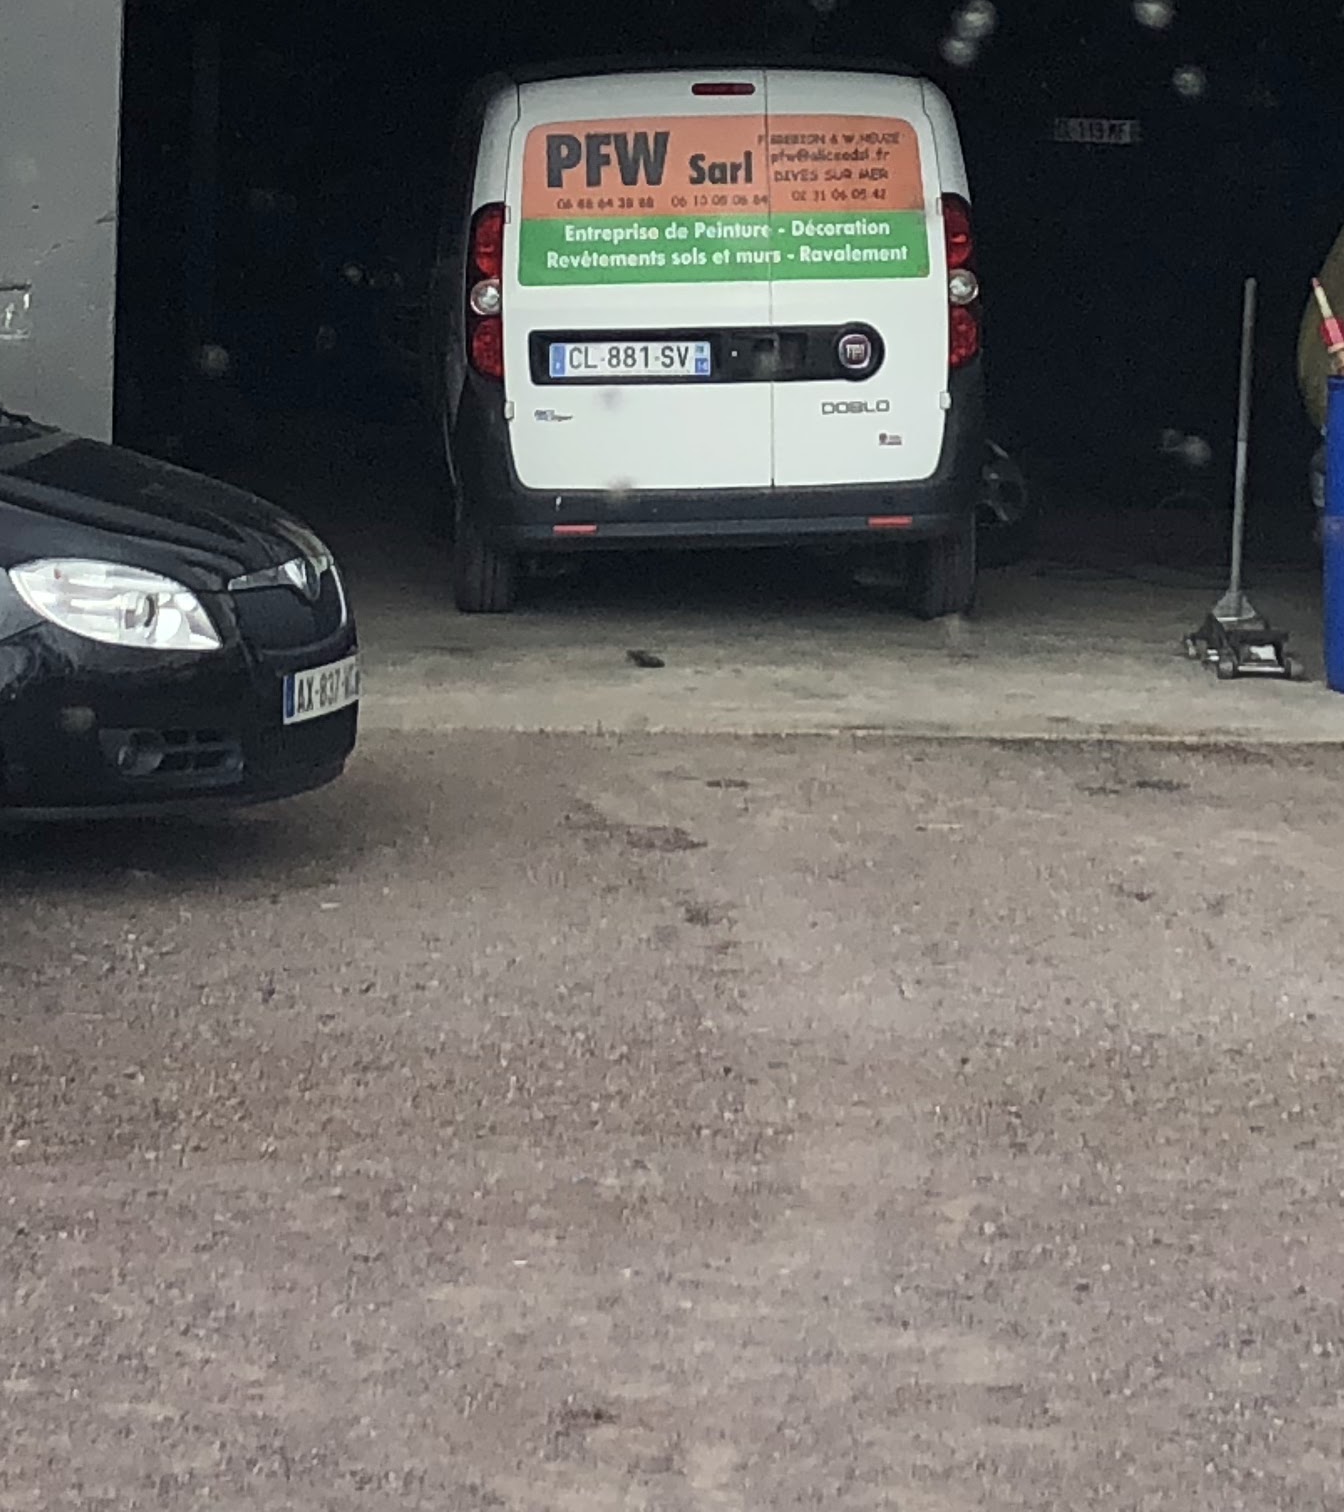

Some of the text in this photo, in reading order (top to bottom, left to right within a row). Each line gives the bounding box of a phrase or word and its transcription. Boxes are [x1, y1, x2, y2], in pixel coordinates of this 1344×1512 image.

[545, 131, 754, 189] PFW Sarl
[564, 223, 659, 245] Entreprise
[664, 222, 689, 239] de
[694, 221, 770, 239] Peinture
[791, 218, 891, 237] Décoration
[671, 247, 707, 265] sols
[712, 249, 730, 265] et
[736, 249, 782, 264] murs
[799, 244, 909, 263] Ravalement
[822, 400, 890, 415] DOBLO
